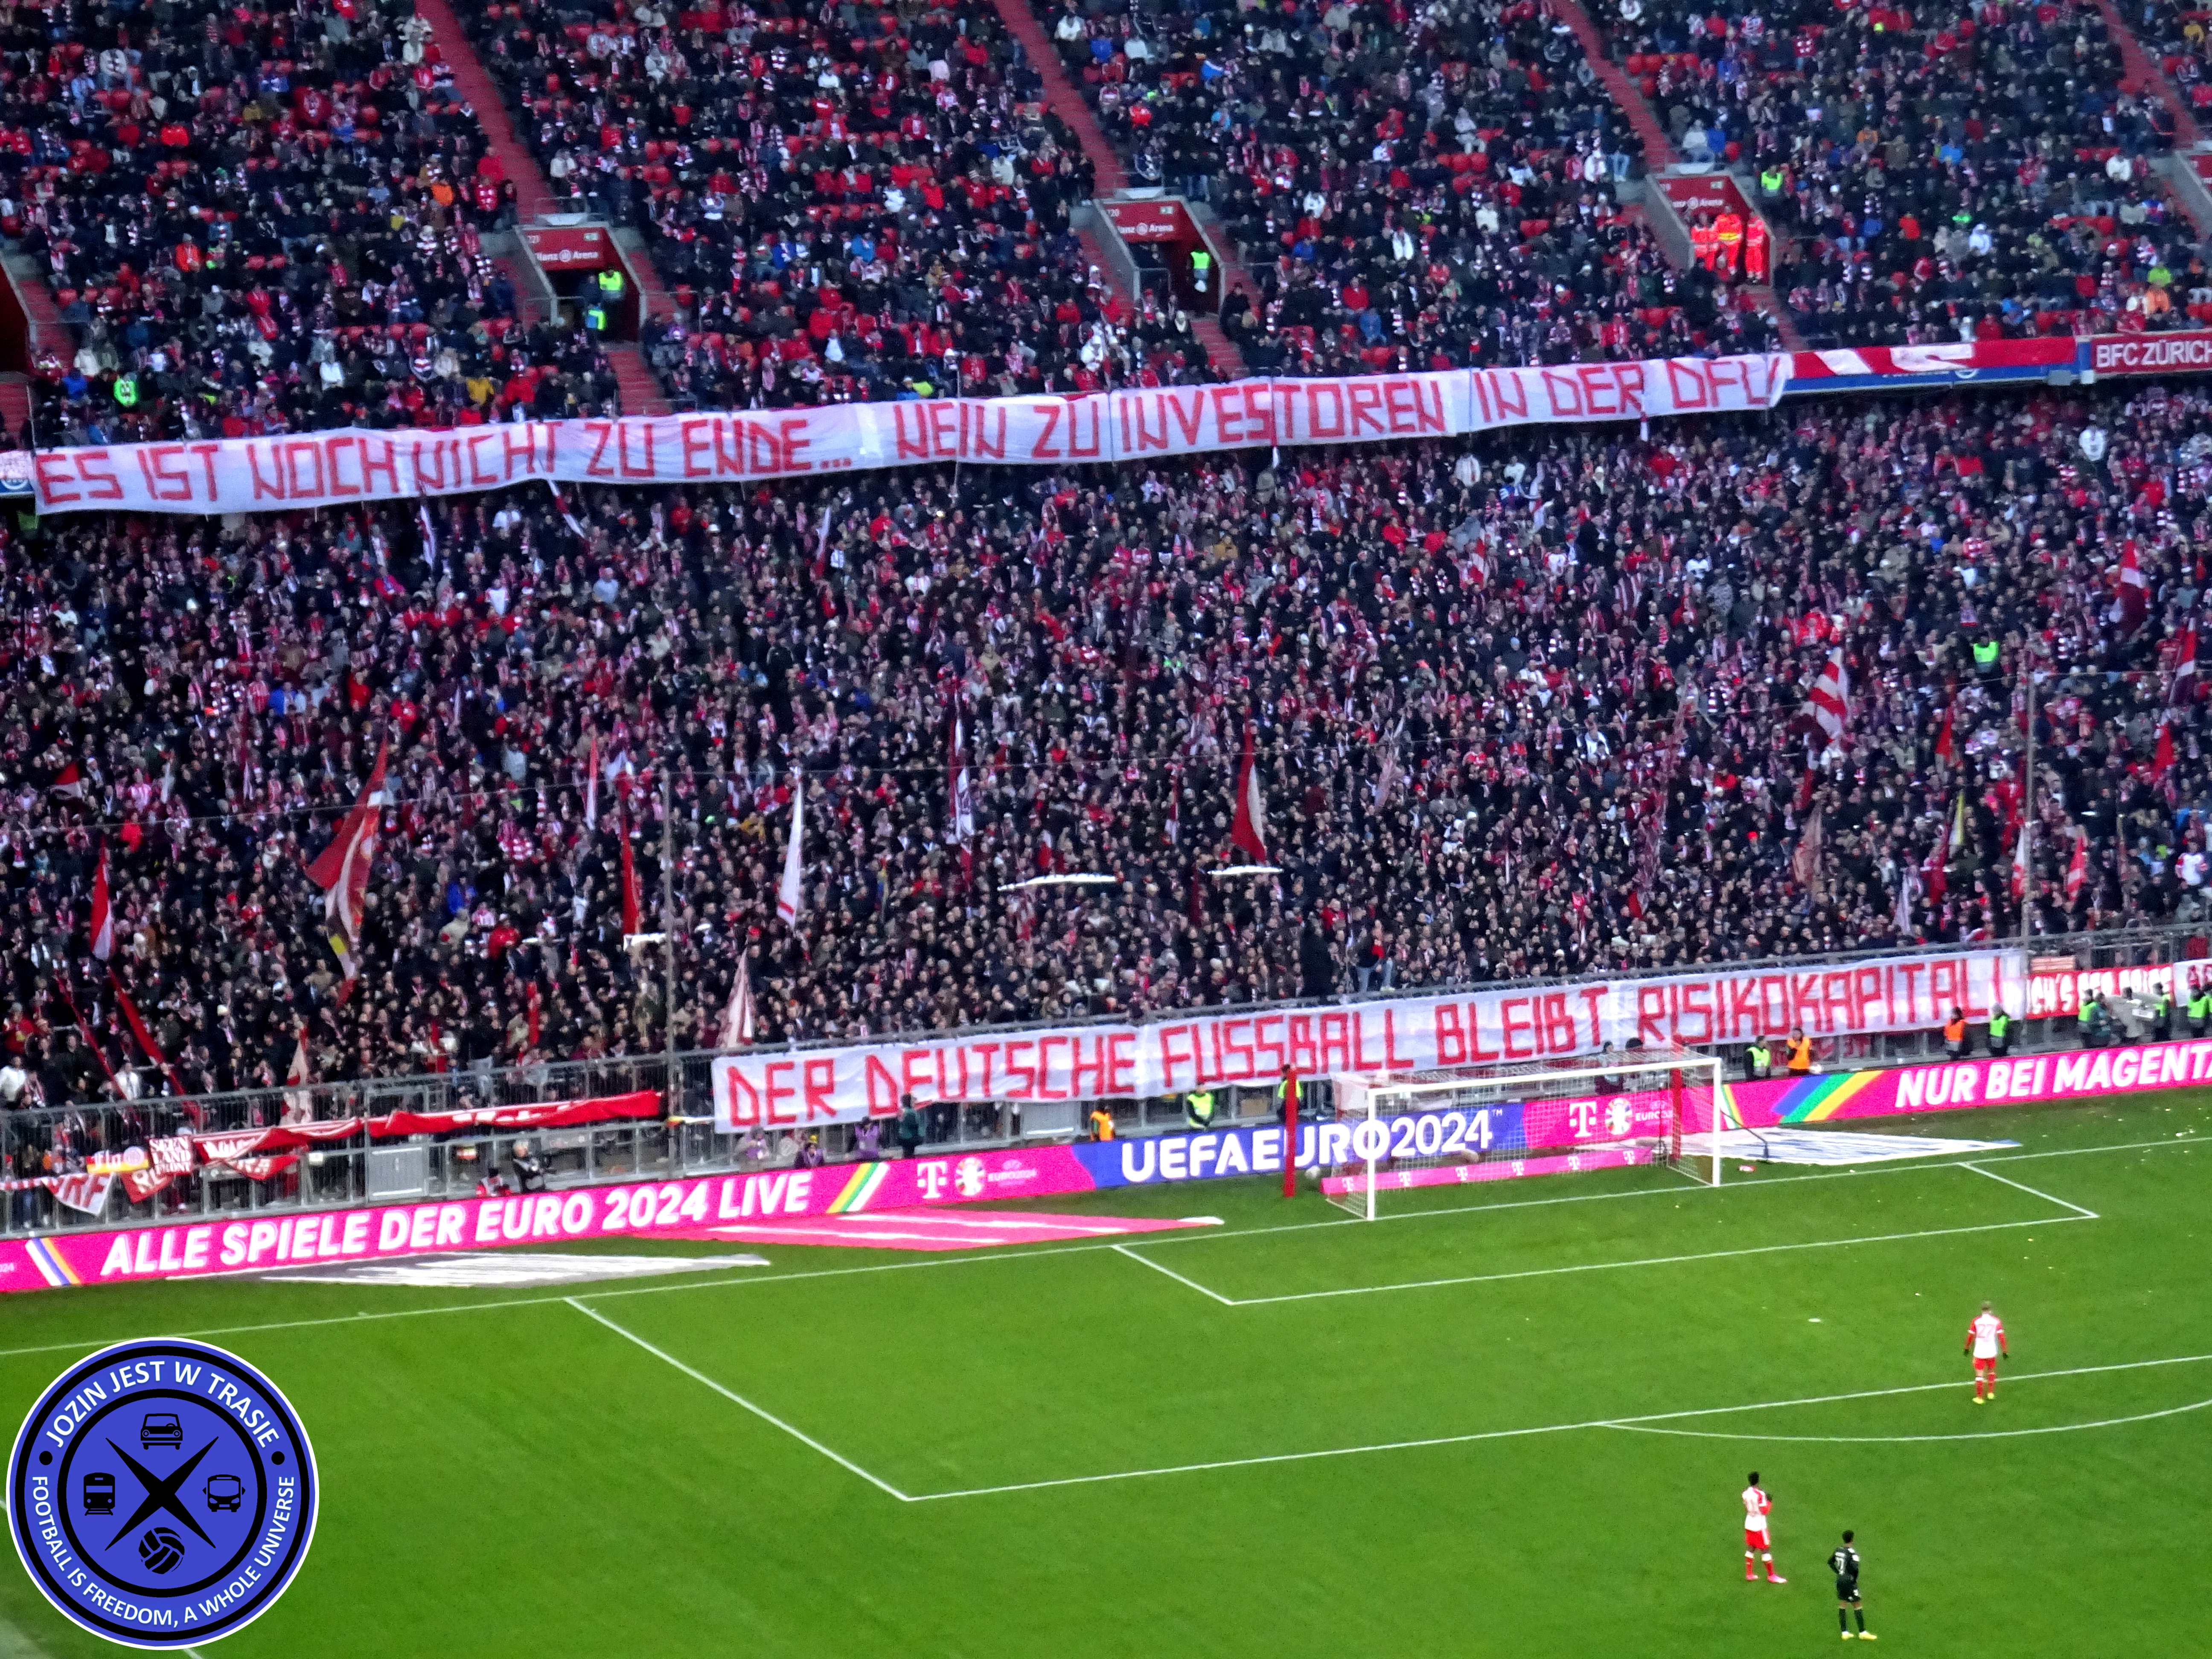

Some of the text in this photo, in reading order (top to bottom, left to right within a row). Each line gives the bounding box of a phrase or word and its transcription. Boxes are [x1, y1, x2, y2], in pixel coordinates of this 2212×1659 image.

[2096, 343, 2138, 367] BFC
[35, 451, 124, 505] ES
[137, 445, 219, 501] IST
[249, 437, 400, 500] NOCH
[412, 421, 563, 490] NICHT
[584, 422, 655, 477] ZU
[683, 419, 851, 477] ENDE...
[893, 401, 1006, 460] NEIN
[1032, 400, 1100, 457] ZU
[1120, 379, 1444, 453] INVESTOREN
[1472, 370, 1528, 423] IN
[1541, 363, 1644, 416] DER
[727, 1059, 836, 1127] DER
[865, 1033, 1135, 1117] DEUTSCHE
[1159, 1008, 1414, 1088] FUSSBALL
[1435, 986, 1609, 1065] BLEIBT
[1895, 1065, 1979, 1107] NUR
[1985, 1057, 2047, 1100] BEI
[100, 1171, 814, 1277] ALLE SPIELE DER EURO 2024 LIVE
